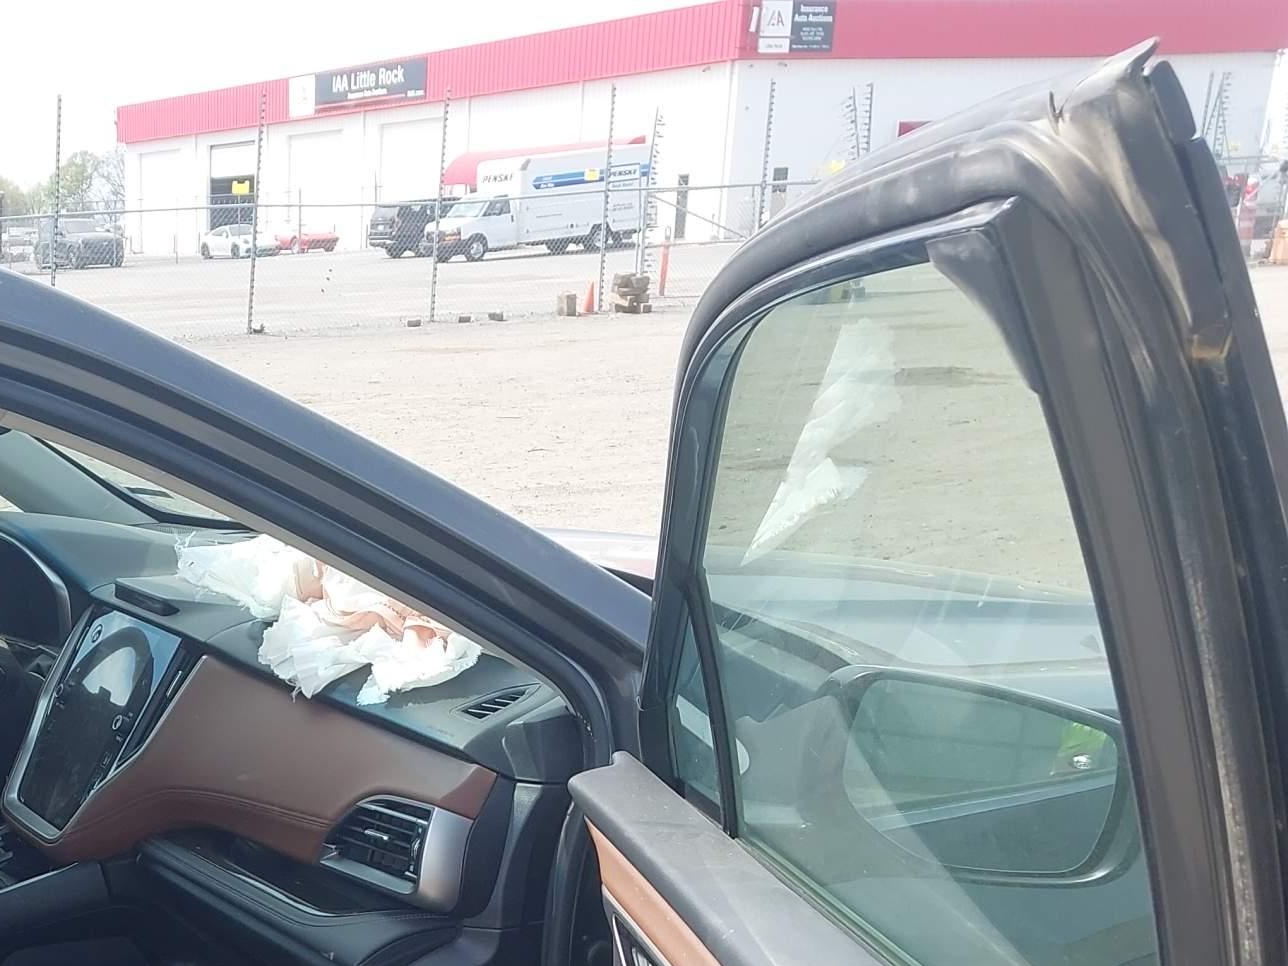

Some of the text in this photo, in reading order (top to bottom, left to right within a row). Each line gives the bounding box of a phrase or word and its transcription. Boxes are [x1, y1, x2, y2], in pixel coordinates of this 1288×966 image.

[332, 64, 405, 92] IAA Little Rock
